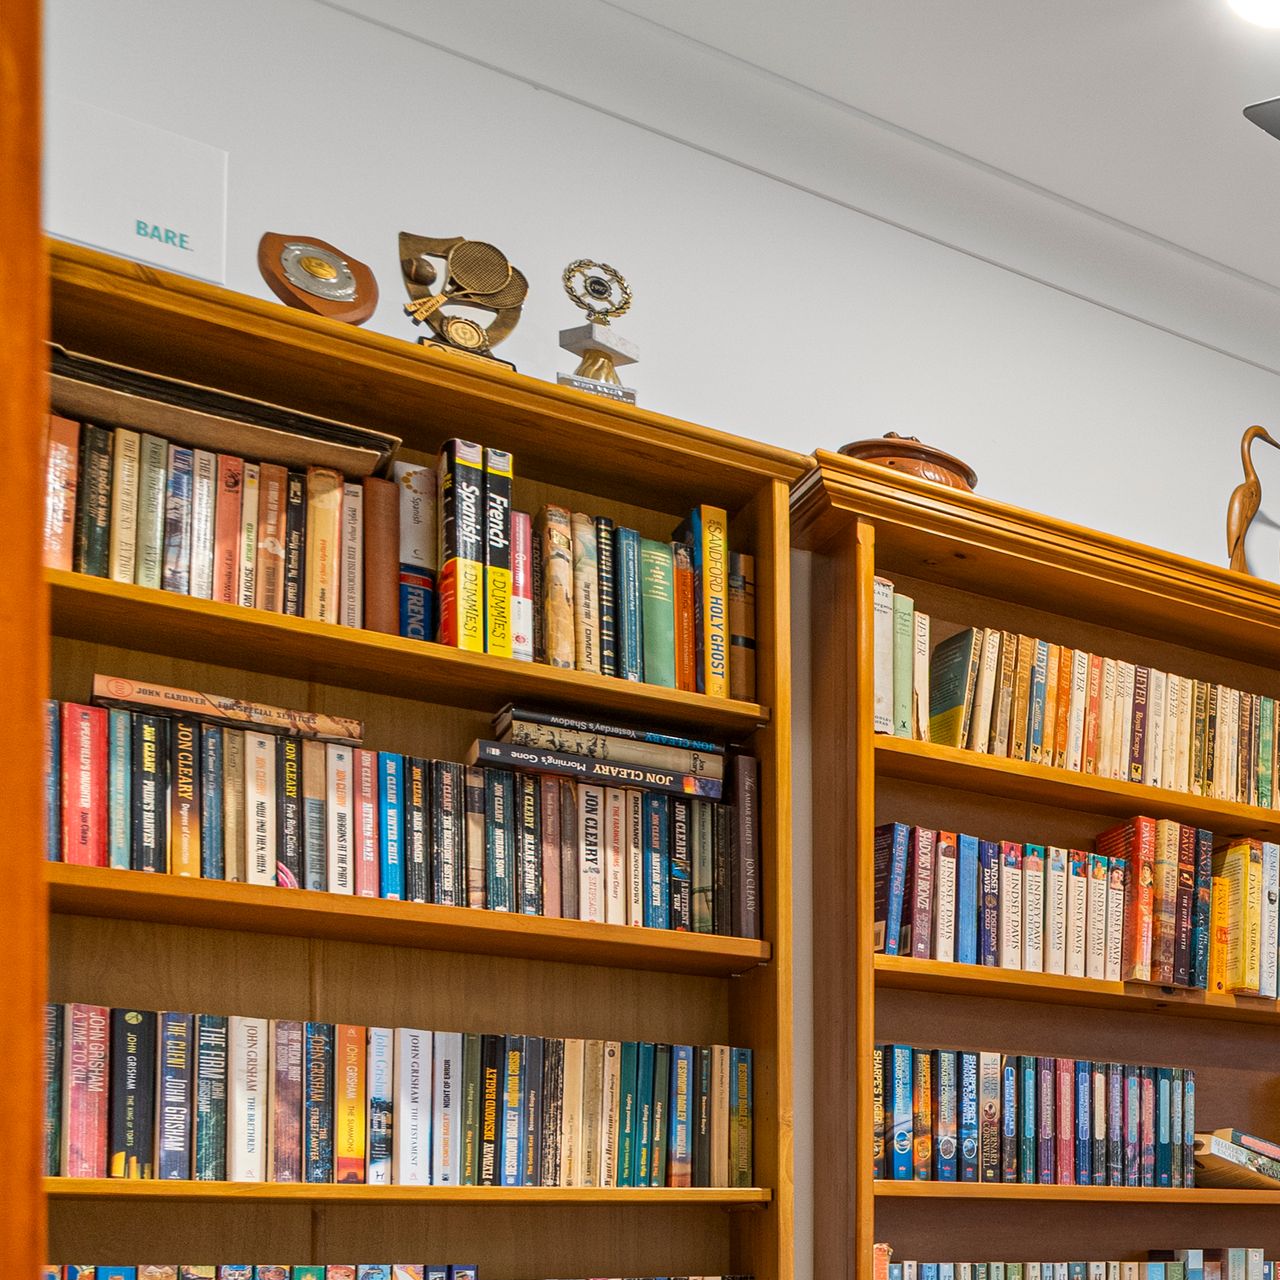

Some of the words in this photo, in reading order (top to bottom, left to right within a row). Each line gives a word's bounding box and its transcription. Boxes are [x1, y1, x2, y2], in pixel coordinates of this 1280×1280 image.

[135, 220, 193, 251] BARE
[413, 497, 422, 524] Spanish
[462, 482, 479, 543] Spanish
[489, 493, 508, 548] French
[515, 552, 526, 587] German
[708, 525, 723, 592] SANDFORD
[710, 596, 723, 629] HOLY
[711, 634, 724, 678] GHOST
[1035, 645, 1046, 683] HEYER
[136, 687, 161, 698] JOHN
[164, 690, 206, 706] GARDNER
[1135, 668, 1147, 705] HEYER
[550, 716, 587, 730] Shadow
[1034, 698, 1042, 730] Cotillion
[1134, 711, 1143, 732] Royal
[143, 725, 155, 741] JON
[178, 724, 192, 750] JON
[589, 722, 636, 738] Yesterday's
[80, 722, 91, 770] SPEARFIELD'S
[144, 742, 155, 773] CLEARY
[285, 741, 297, 760] JON
[511, 751, 538, 763] Gone
[1133, 733, 1142, 757] Escape
[178, 752, 193, 800] CLEARY
[541, 756, 586, 772] Morning's
[593, 763, 643, 781] CLEARY
[647, 772, 673, 785] JON
[80, 771, 91, 808] DAUGHTER
[285, 762, 297, 798] CLEARY
[143, 780, 155, 810] PRIDE'S
[81, 812, 89, 822] Jon
[180, 803, 190, 825] Degrees
[286, 804, 295, 818] Five
[675, 802, 686, 821] JON
[80, 824, 89, 845] Cleary
[144, 812, 155, 849] HARVEST
[285, 819, 295, 834] Ring
[181, 833, 190, 864] Connection
[286, 836, 296, 857] Circus
[676, 823, 686, 860] CLEARY
[983, 869, 991, 893] DAVIS
[990, 859, 998, 895] LINDSEY
[1269, 847, 1277, 886] NEMESIS
[673, 894, 681, 910] TURF
[681, 888, 689, 925] DIFFERENT
[1268, 910, 1276, 947] LINDSEY
[74, 1010, 86, 1019] A
[89, 1012, 104, 1041] JOHN
[73, 1022, 86, 1045] TIME
[127, 1032, 137, 1053] JOHN
[168, 1022, 186, 1037] THE
[200, 1028, 225, 1046] THE
[244, 1025, 257, 1048] JOHN
[73, 1048, 86, 1062] TO
[88, 1043, 104, 1092] GRISHAM
[167, 1040, 186, 1069] CLIENT
[199, 1050, 225, 1079] FIRM
[73, 1065, 86, 1086] KILL
[126, 1056, 136, 1089] GRISHAM
[246, 1050, 257, 1091] GRISHAM
[484, 1068, 497, 1099] BAGLEY
[164, 1076, 186, 1102] JOHN
[198, 1080, 210, 1112] GRISHAM
[211, 1081, 224, 1099] JOHN
[247, 1097, 255, 1112] THE
[164, 1107, 187, 1151] GRISHAM
[247, 1113, 255, 1153] BRETHREN
[484, 1100, 496, 1140] DESMOND
[126, 1130, 134, 1146] TORTS
[483, 1142, 494, 1179] FLYAWAY
